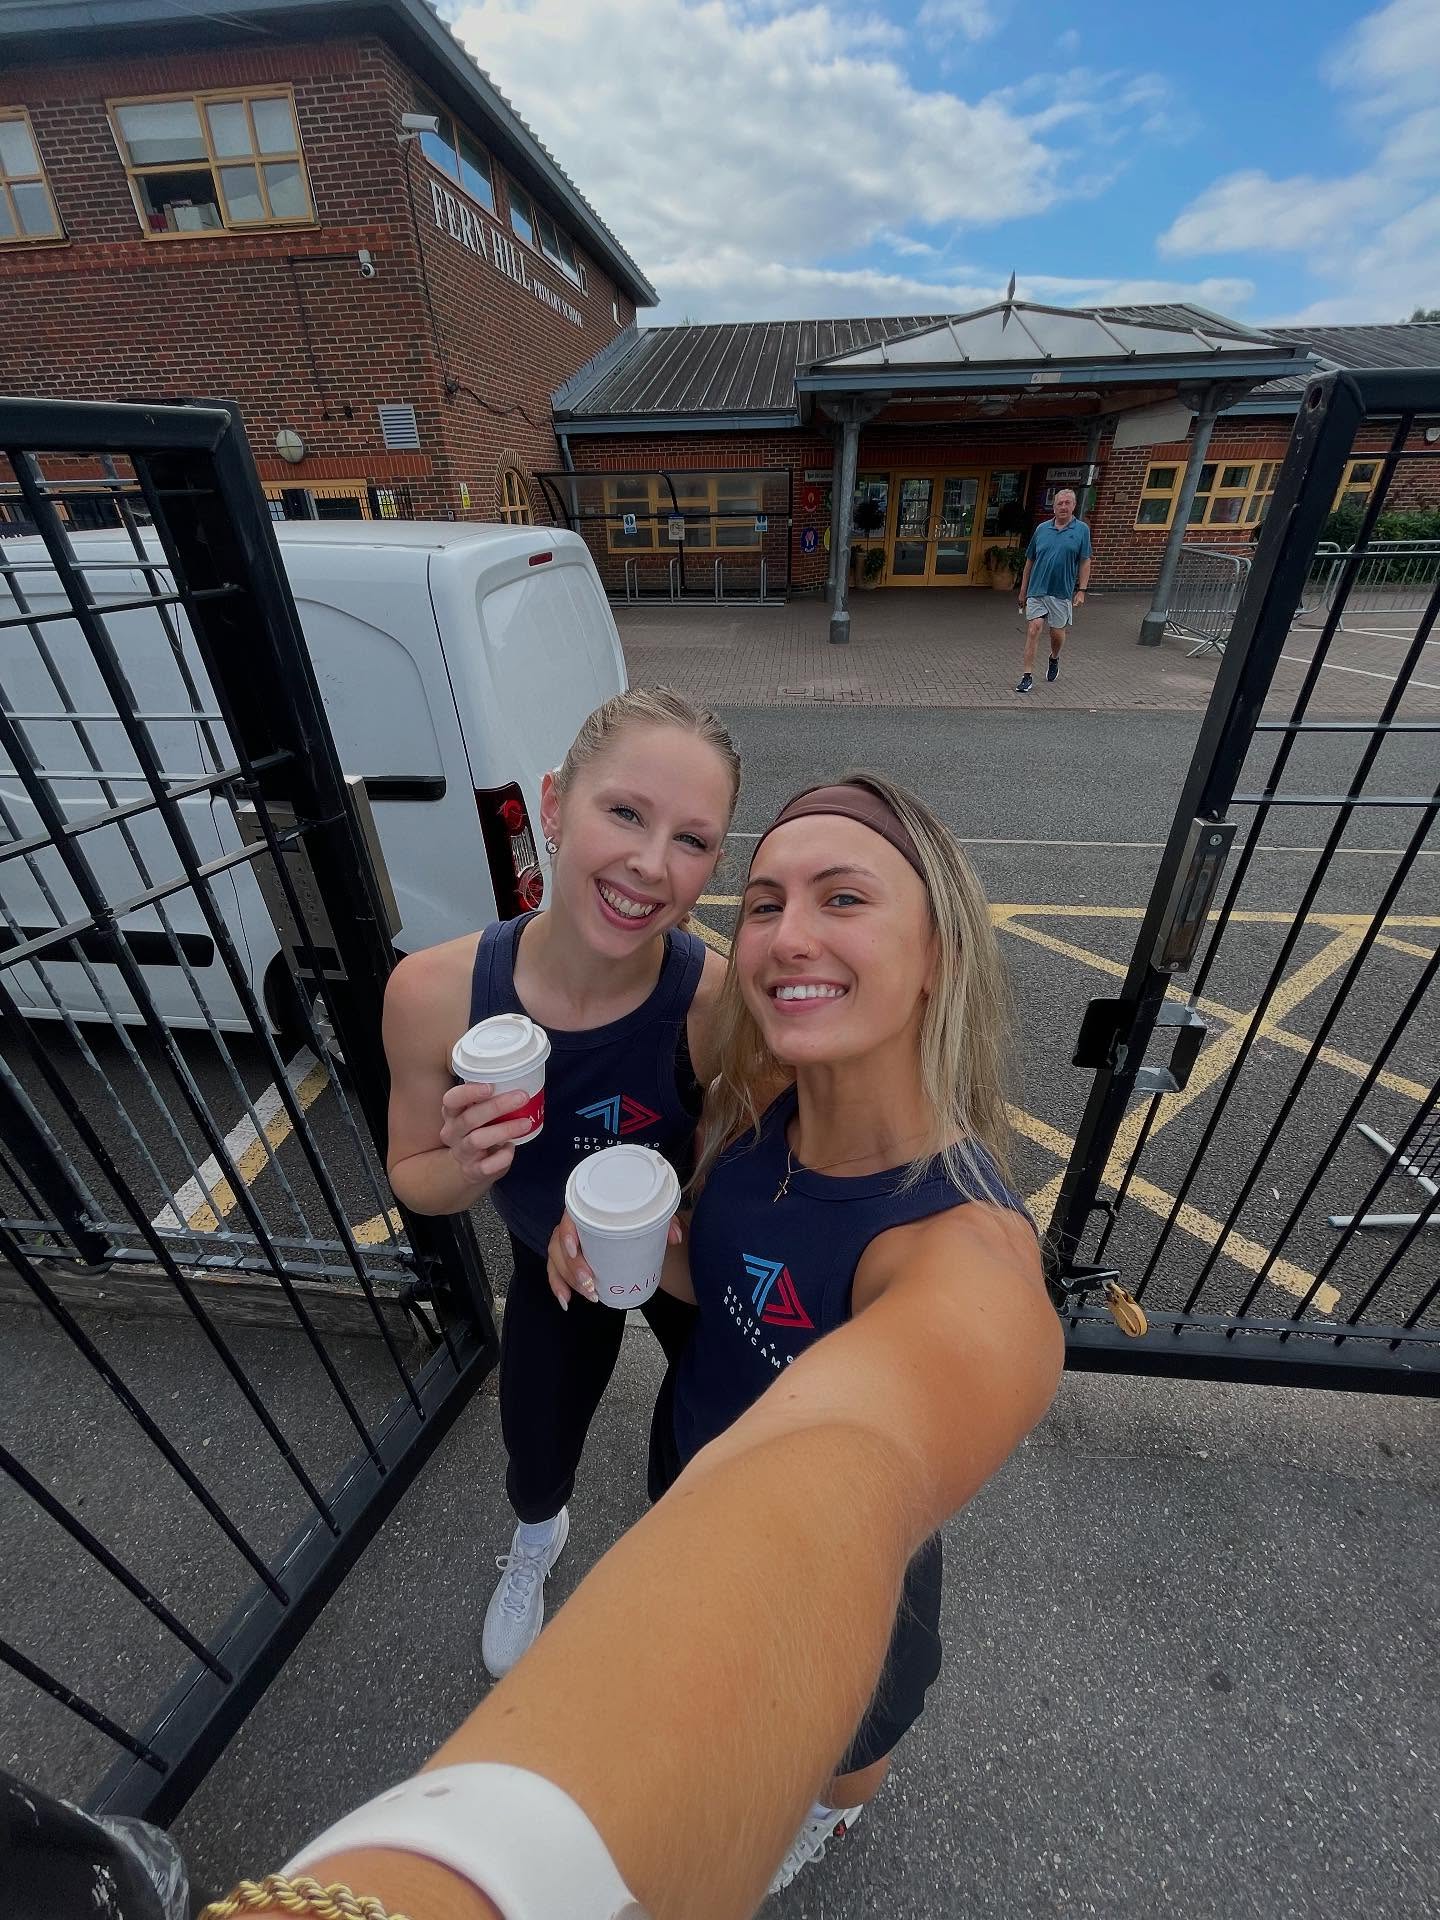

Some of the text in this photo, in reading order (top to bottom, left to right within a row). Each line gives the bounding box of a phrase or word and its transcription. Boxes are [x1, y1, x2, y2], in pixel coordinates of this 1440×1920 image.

[429, 179, 584, 329] FERN HILL PRIMARY SCHOOL
[573, 1136, 599, 1144] GET
[607, 1139, 622, 1147] UP
[727, 1285, 743, 1312] GET
[747, 1317, 761, 1336] UP
